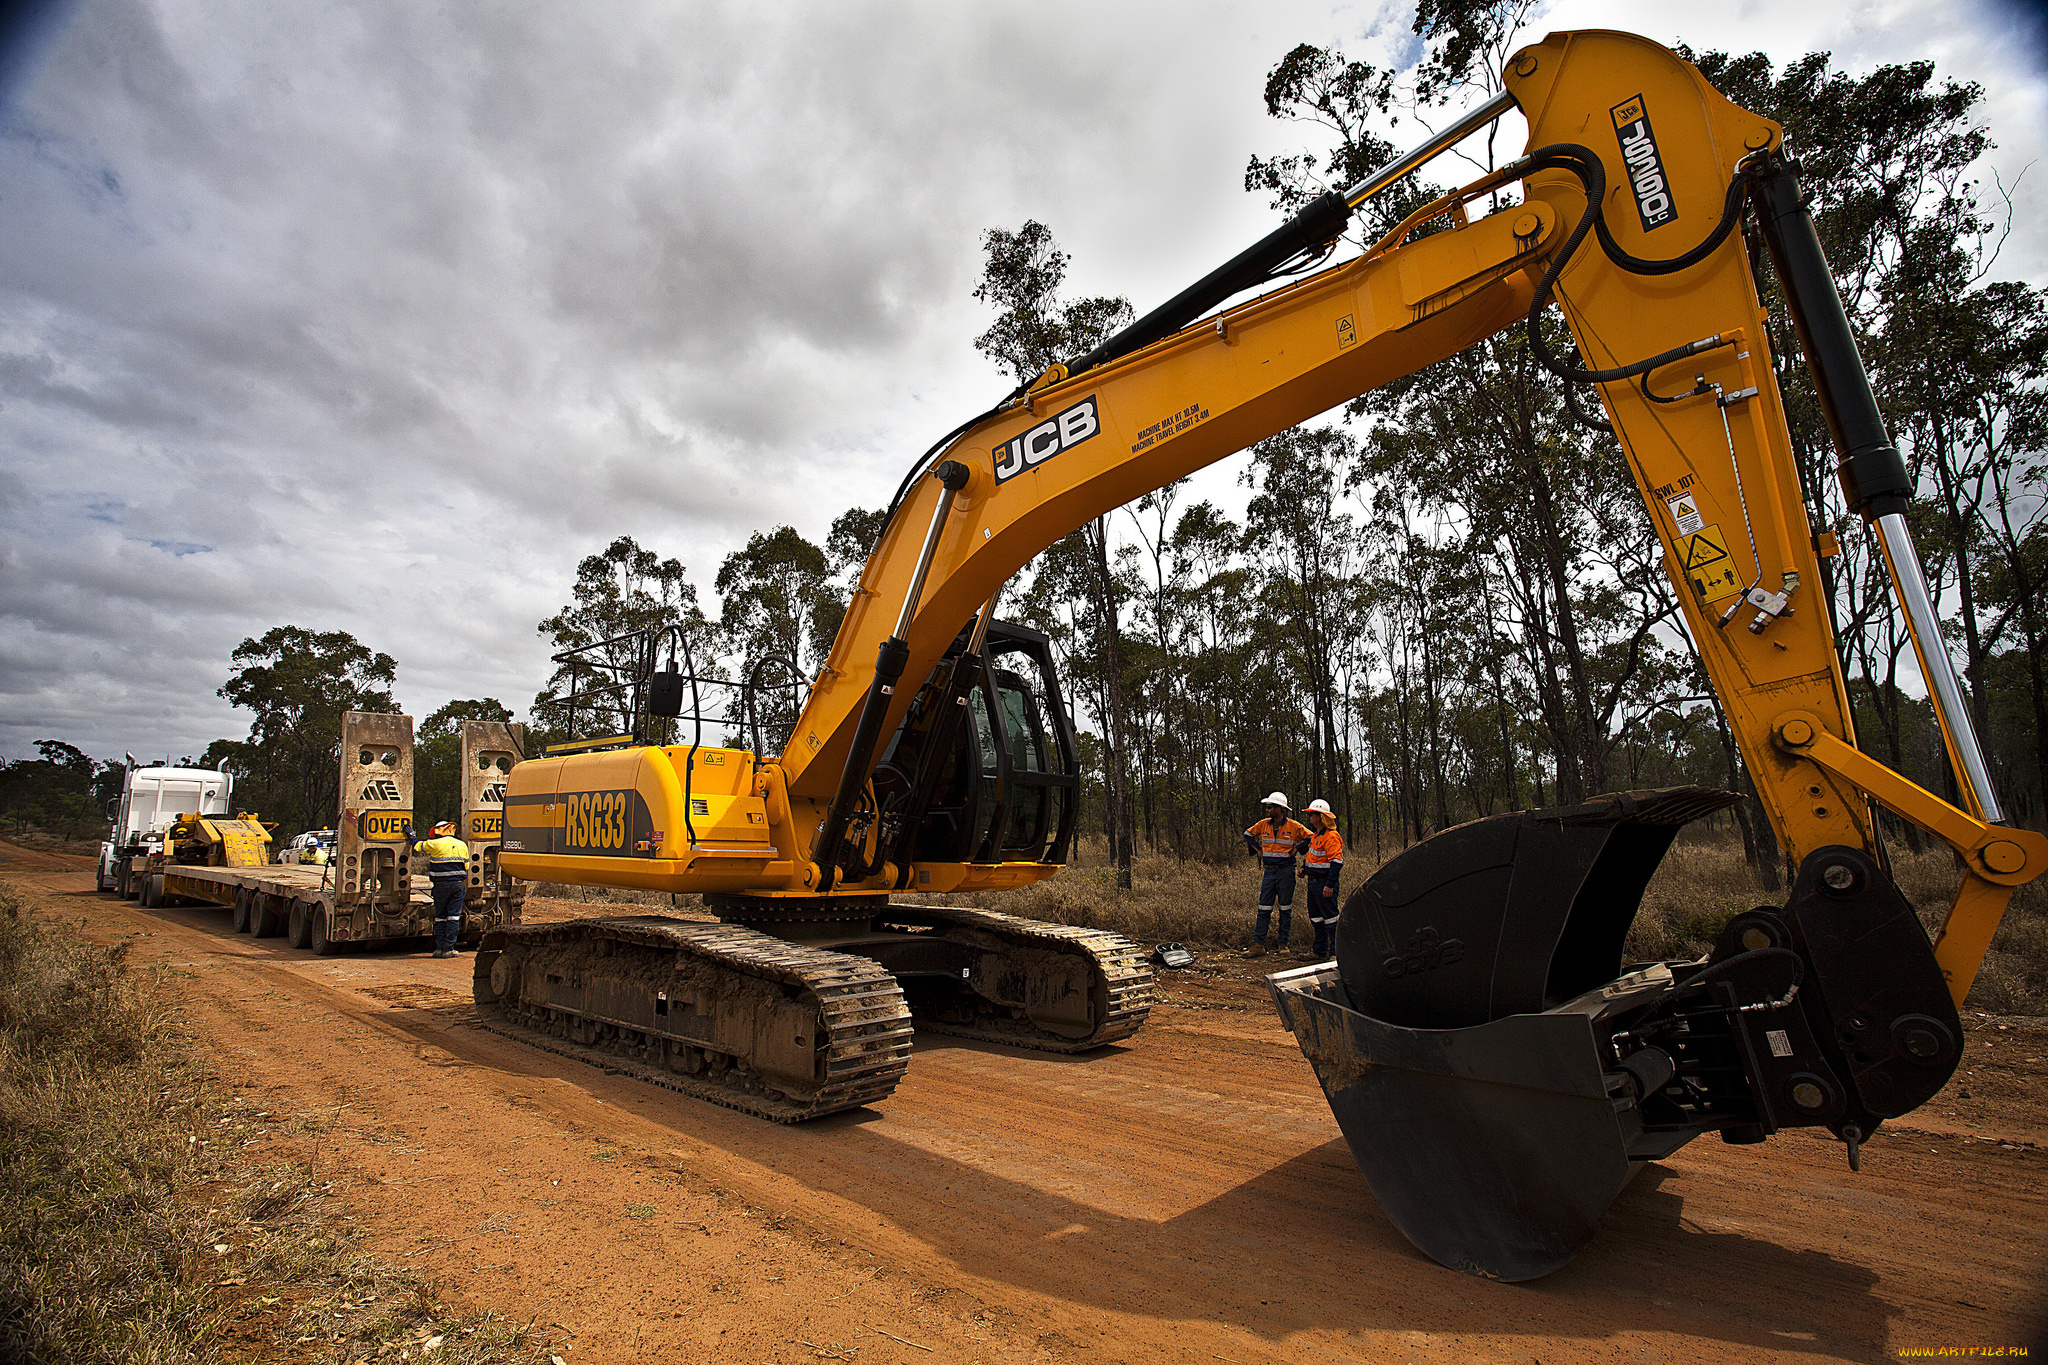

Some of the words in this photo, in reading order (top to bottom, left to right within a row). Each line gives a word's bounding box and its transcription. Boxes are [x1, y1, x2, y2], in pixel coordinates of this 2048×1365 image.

[1620, 105, 1639, 120] JCB
[1622, 120, 1669, 218] JS290
[1648, 210, 1669, 225] LC
[996, 402, 1097, 480] JCB
[1131, 436, 1155, 454] MACHINE
[1155, 426, 1175, 442] TRAVEL
[1175, 417, 1194, 433] HEIGHT
[1194, 408, 1210, 423] 3.4M
[1137, 422, 1161, 441] MACHINE
[1161, 415, 1175, 429] MAX
[1654, 483, 1678, 500] SWL
[1677, 473, 1695, 490] 10T
[367, 817, 411, 833] OVER
[565, 792, 626, 849] RSG33
